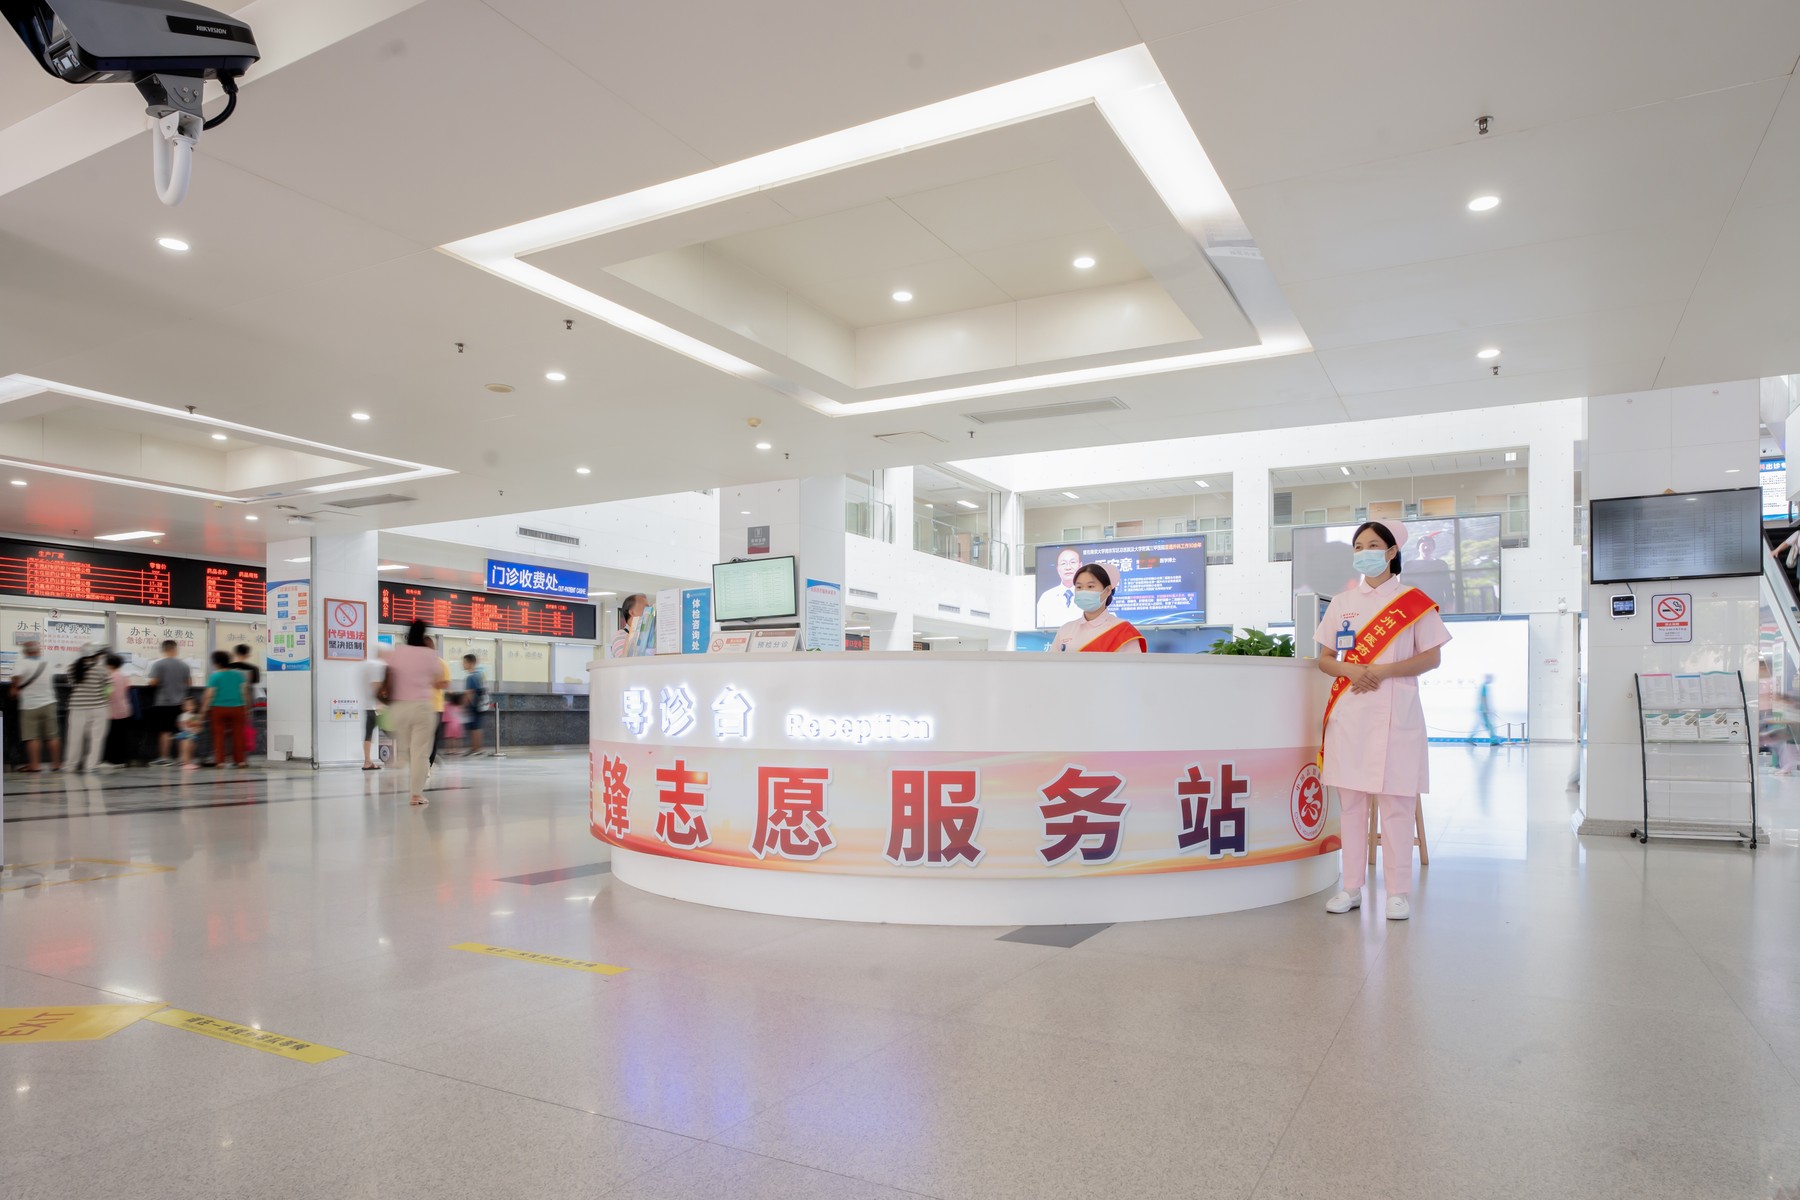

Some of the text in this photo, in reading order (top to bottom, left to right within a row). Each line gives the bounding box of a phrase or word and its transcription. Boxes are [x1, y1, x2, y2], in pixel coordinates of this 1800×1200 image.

[196, 25, 227, 35] HIKVISION
[491, 565, 558, 591] 门诊收费处
[382, 588, 390, 618] 价格公示
[52, 609, 58, 618] 2
[17, 620, 92, 634] 办卡、收费处
[159, 617, 165, 625] 3
[252, 622, 258, 631] 4
[692, 598, 701, 651] 体检咨询处
[130, 627, 194, 640] 办卡、收费处
[328, 629, 366, 640] 代孕违法
[757, 640, 789, 649] 预检分诊
[621, 686, 752, 738] 导诊台
[787, 713, 931, 744] Reception
[590, 752, 1248, 863] 锋志愿服务站
[0, 1011, 75, 1037] EXIT
